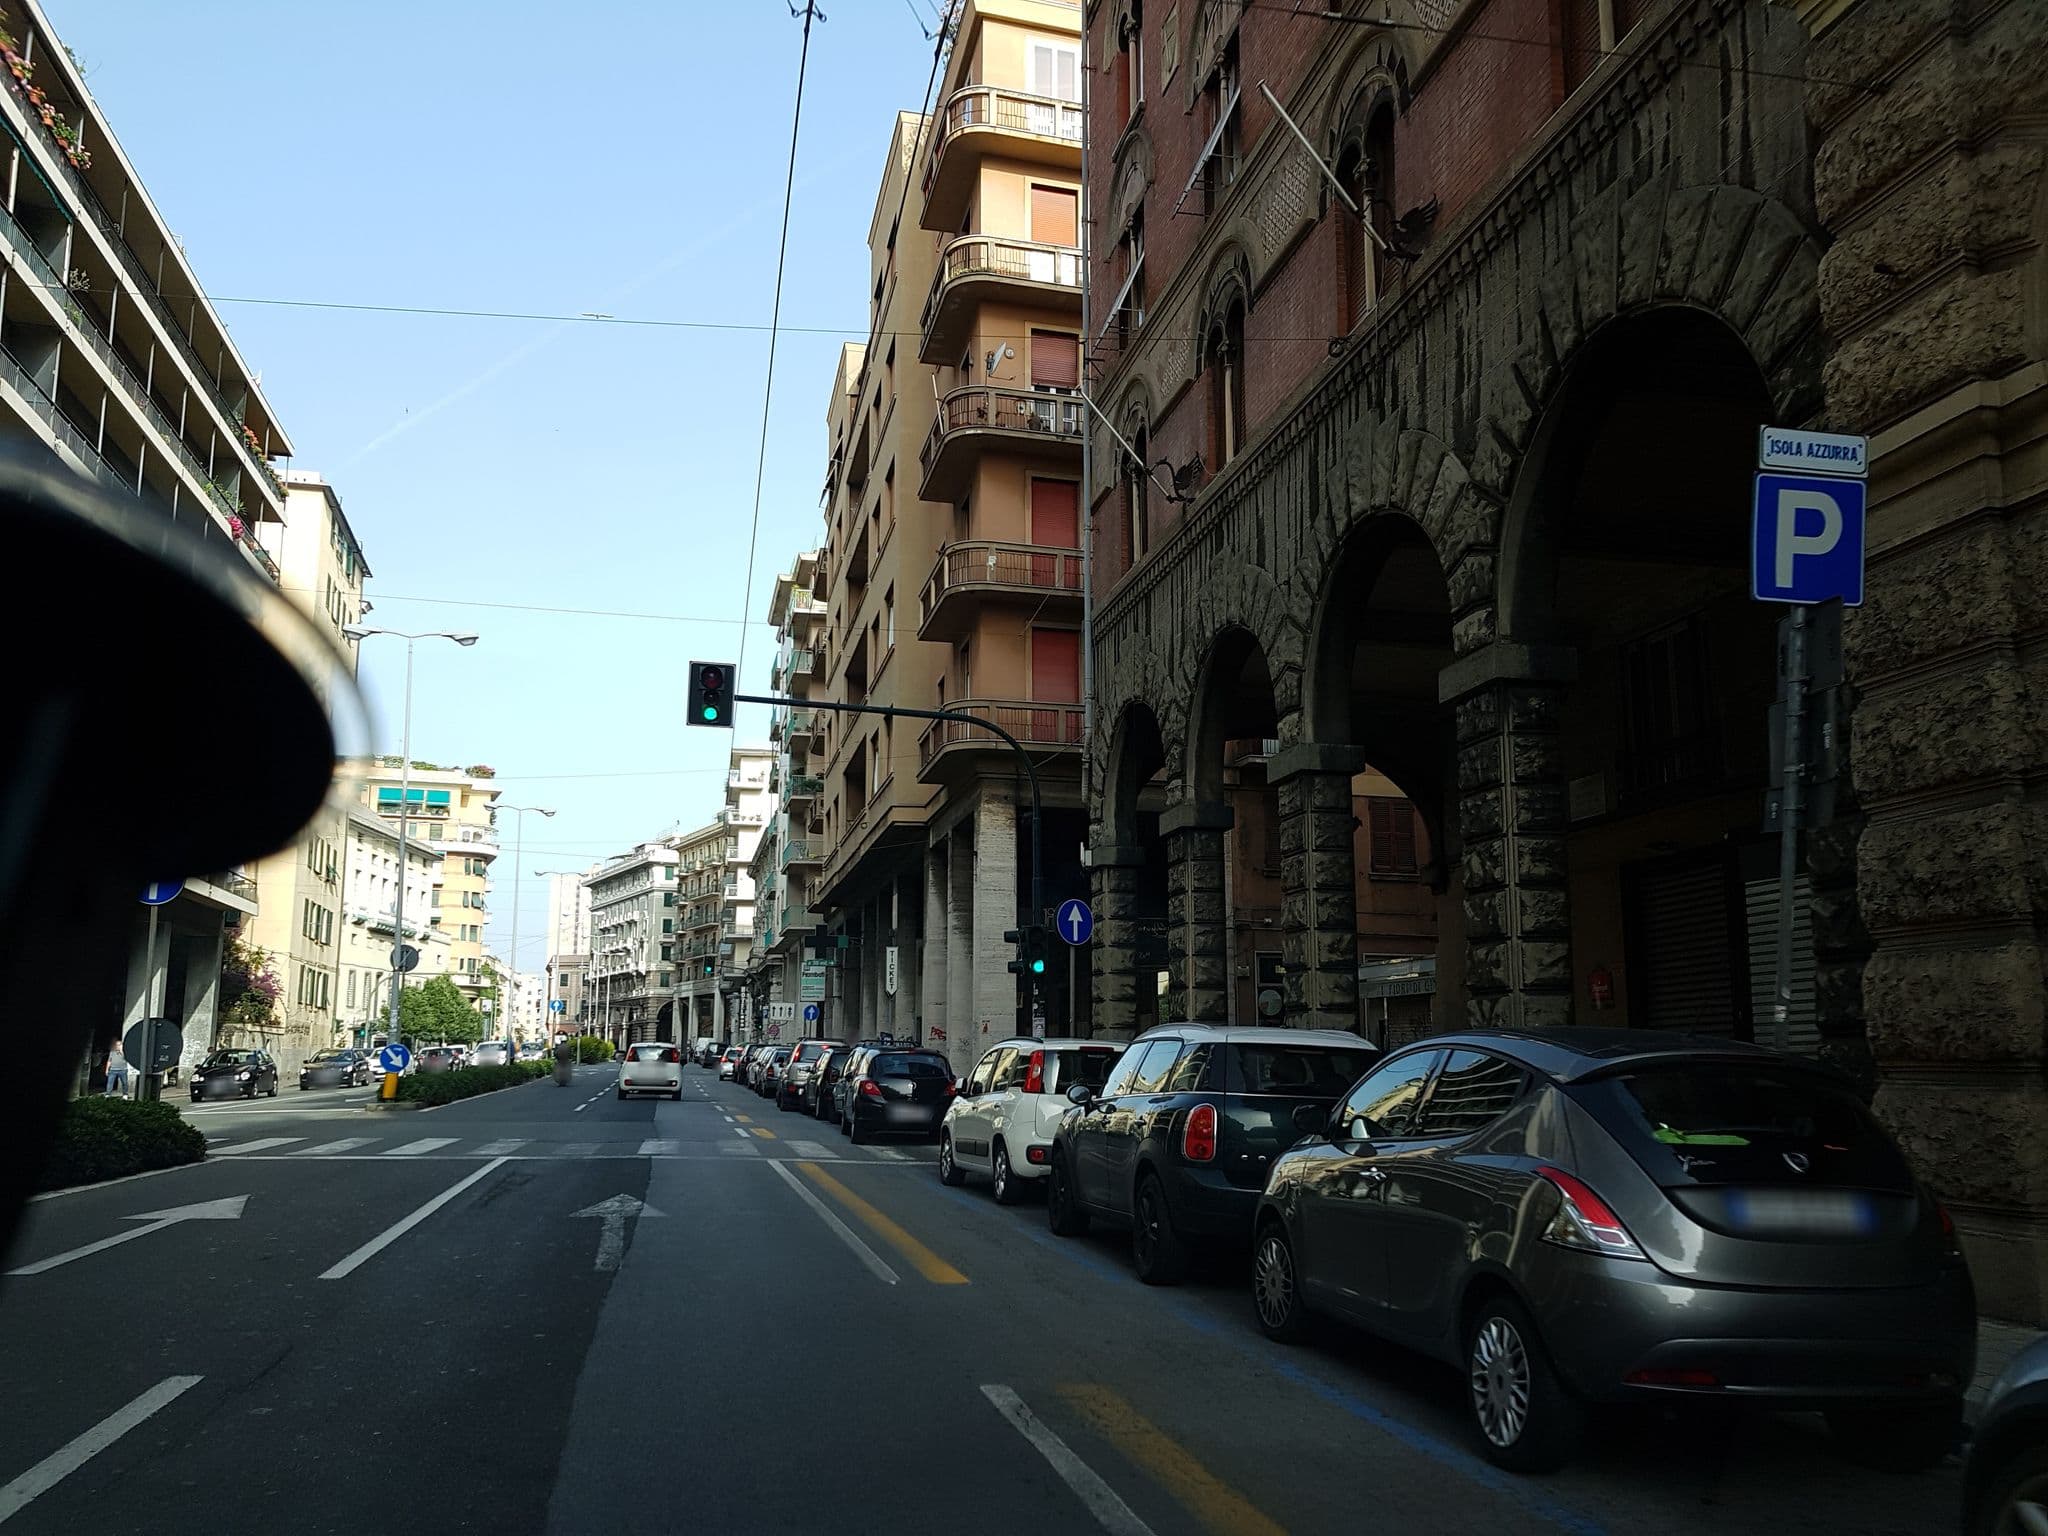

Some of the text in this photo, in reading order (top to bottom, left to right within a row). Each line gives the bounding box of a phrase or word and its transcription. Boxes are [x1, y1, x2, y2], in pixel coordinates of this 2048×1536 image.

[1770, 439, 1858, 461] ISOLA AZZURRA
[1775, 488, 1843, 589] P
